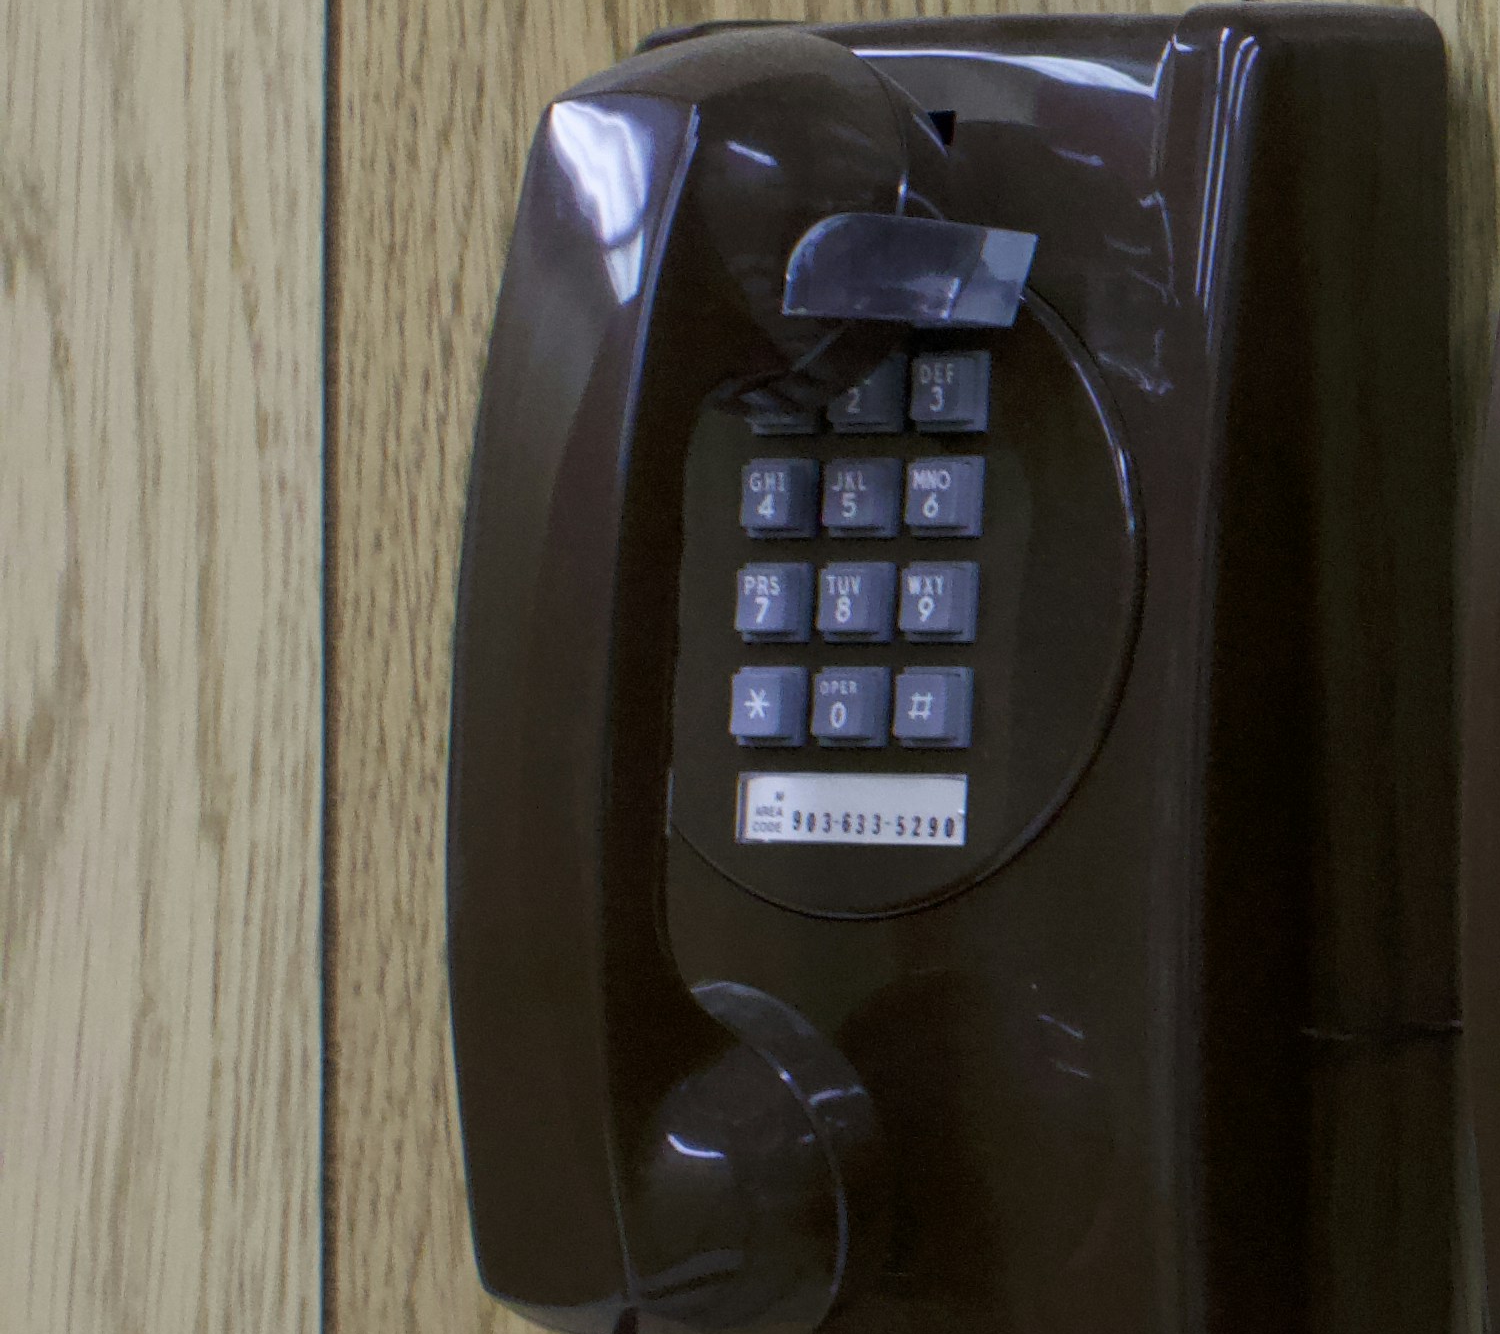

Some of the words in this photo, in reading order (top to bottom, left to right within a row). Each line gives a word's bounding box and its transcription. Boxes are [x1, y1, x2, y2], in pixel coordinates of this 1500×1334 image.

[919, 363, 955, 384] DEF
[846, 387, 861, 414] 2
[929, 386, 945, 412] 3
[749, 471, 785, 492] GHI
[832, 471, 866, 492] JKL
[912, 469, 952, 491] MNO
[756, 494, 776, 520] 4
[841, 493, 857, 518] 5
[922, 493, 939, 518] 6
[744, 575, 781, 596] PRS
[826, 575, 861, 595] TUV
[907, 575, 944, 596] WXY
[754, 596, 771, 624] 7
[835, 596, 852, 624] 8
[917, 596, 935, 622] 9
[820, 680, 858, 695] OPER
